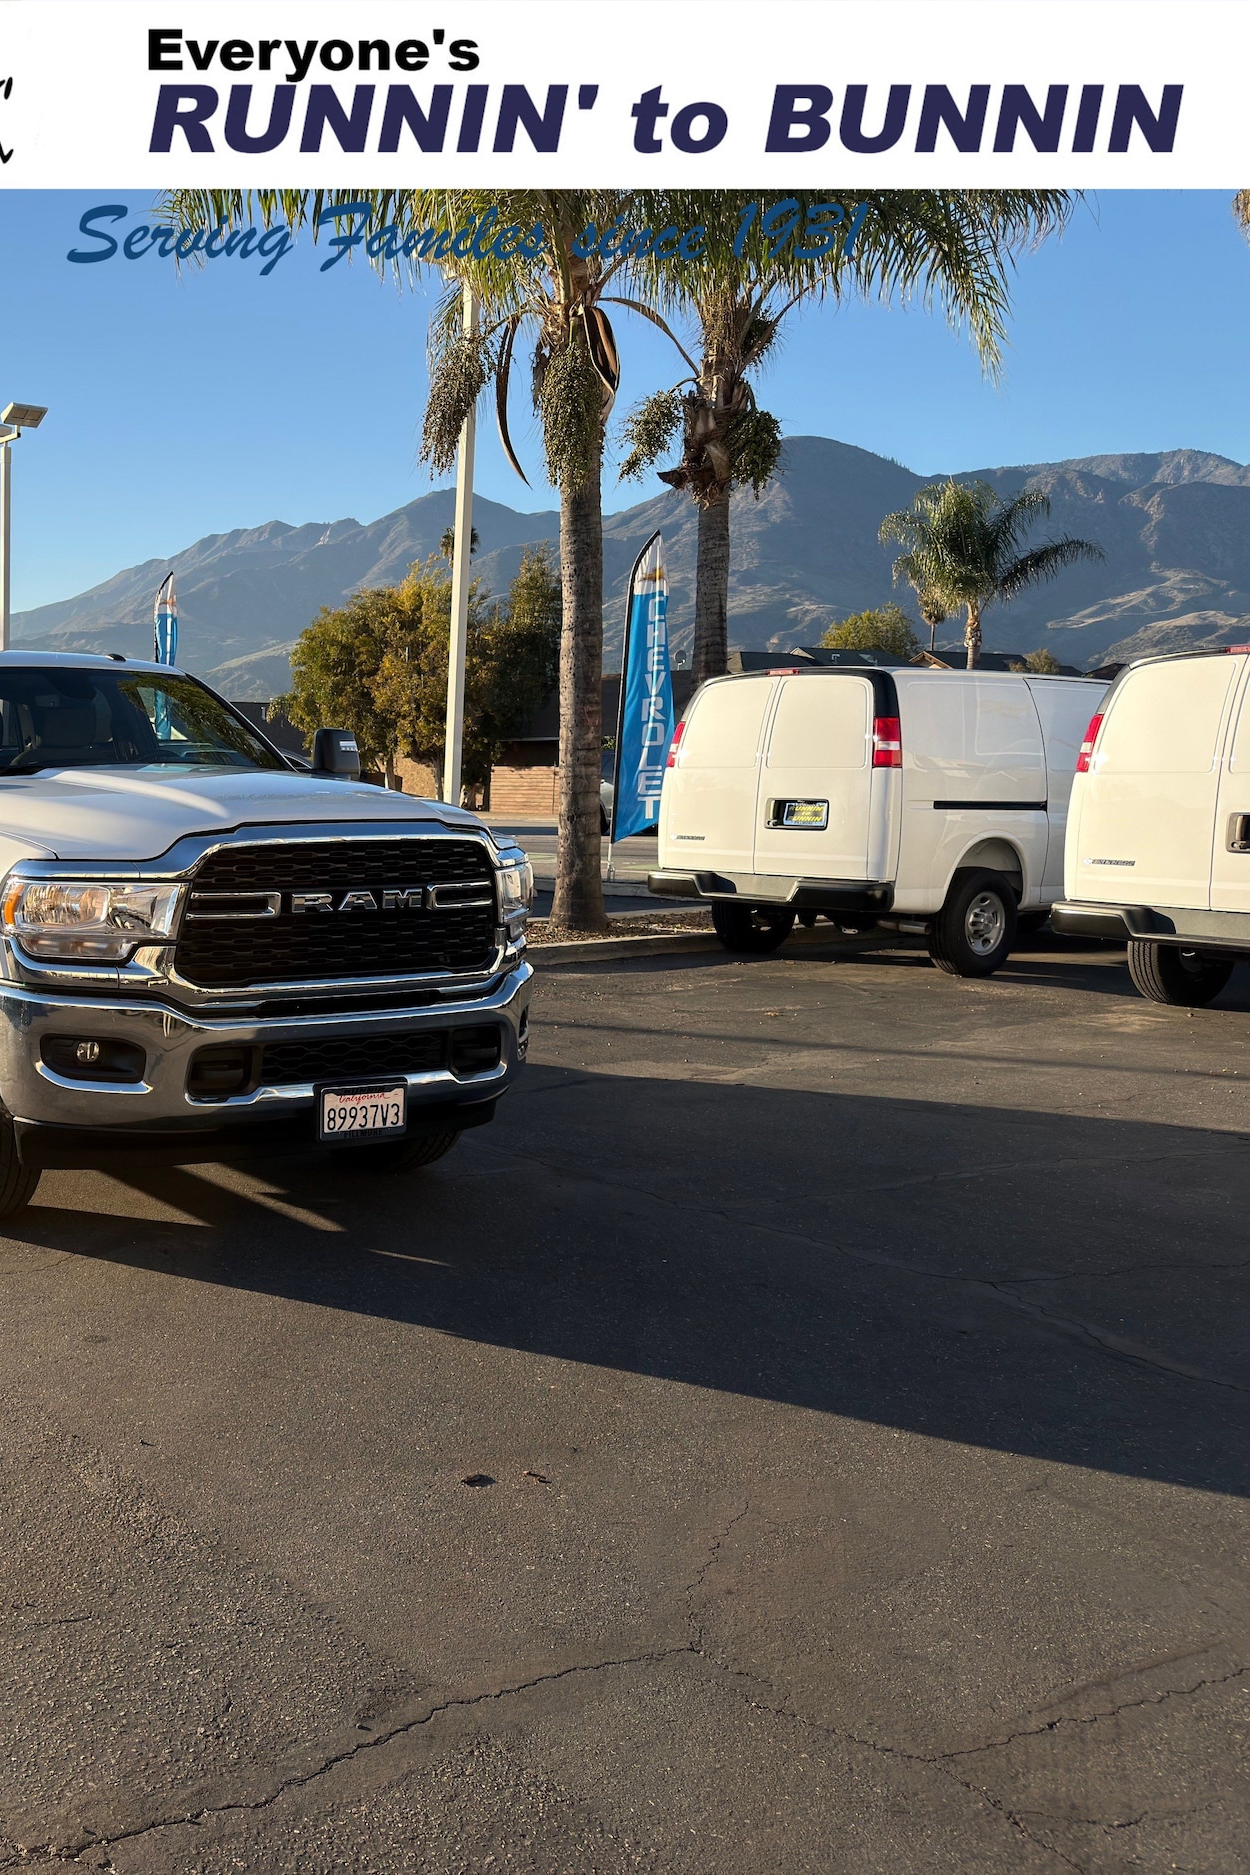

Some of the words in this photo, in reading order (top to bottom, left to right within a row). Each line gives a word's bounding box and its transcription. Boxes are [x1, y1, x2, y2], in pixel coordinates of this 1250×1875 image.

[637, 597, 667, 819] CHEVROLET
[292, 889, 422, 913] RAM
[339, 1092, 390, 1105] California
[327, 1103, 400, 1131] 89937V3
